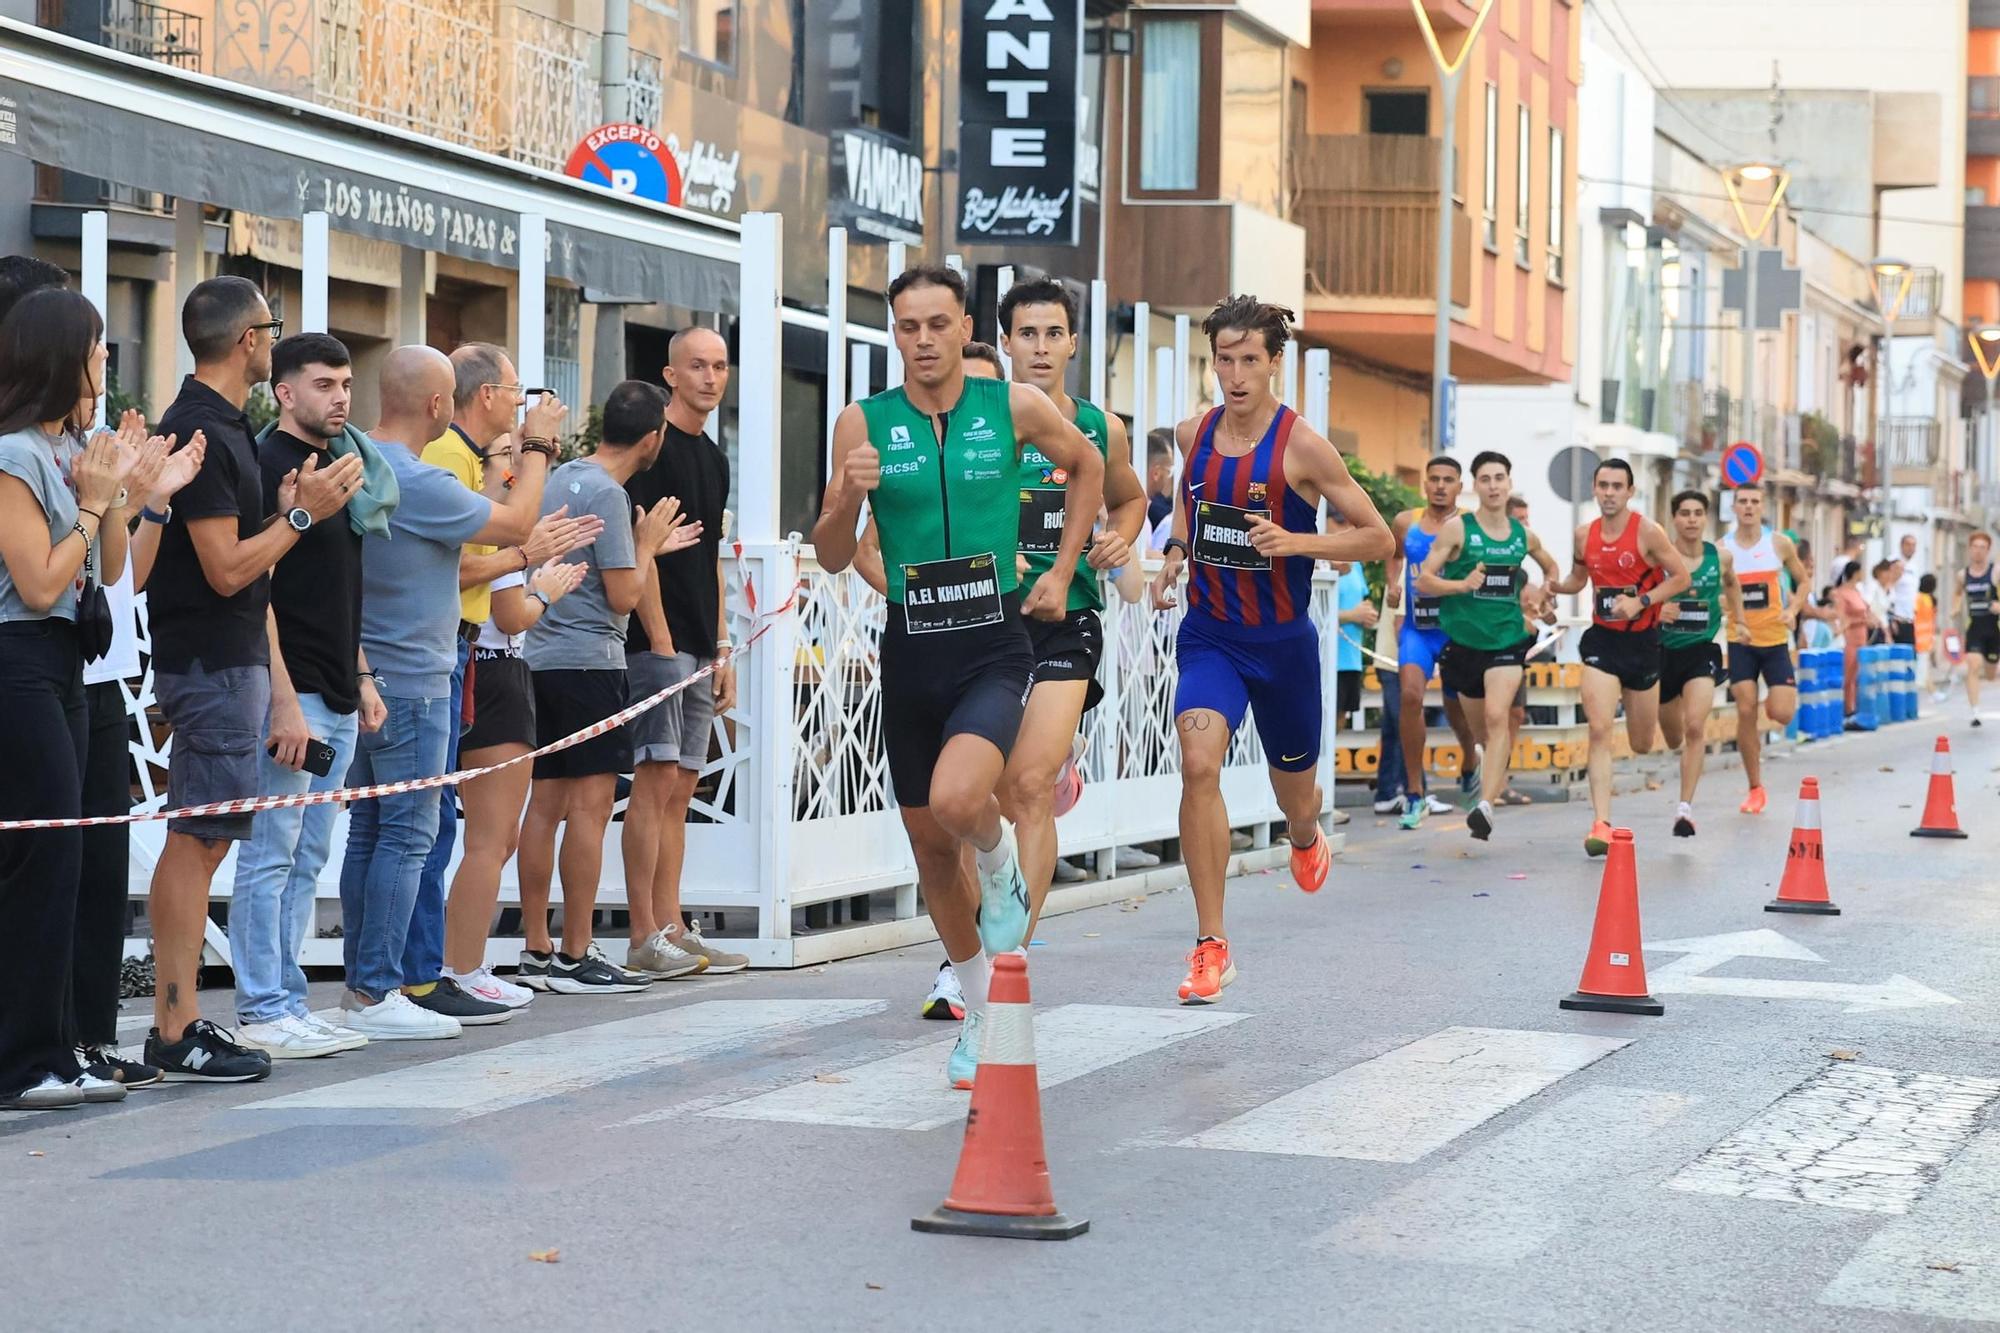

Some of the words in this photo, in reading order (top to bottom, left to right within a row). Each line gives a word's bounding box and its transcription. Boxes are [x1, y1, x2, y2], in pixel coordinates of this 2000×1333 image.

[586, 125, 661, 152] EXCEPTO
[323, 178, 362, 220] LOS
[366, 187, 434, 236] MAÑOS
[441, 206, 497, 250] TAPAS
[500, 225, 516, 255] &
[908, 587, 936, 606] A.EL
[937, 578, 995, 603] KHAYAMI
[1182, 711, 1211, 733] 50
